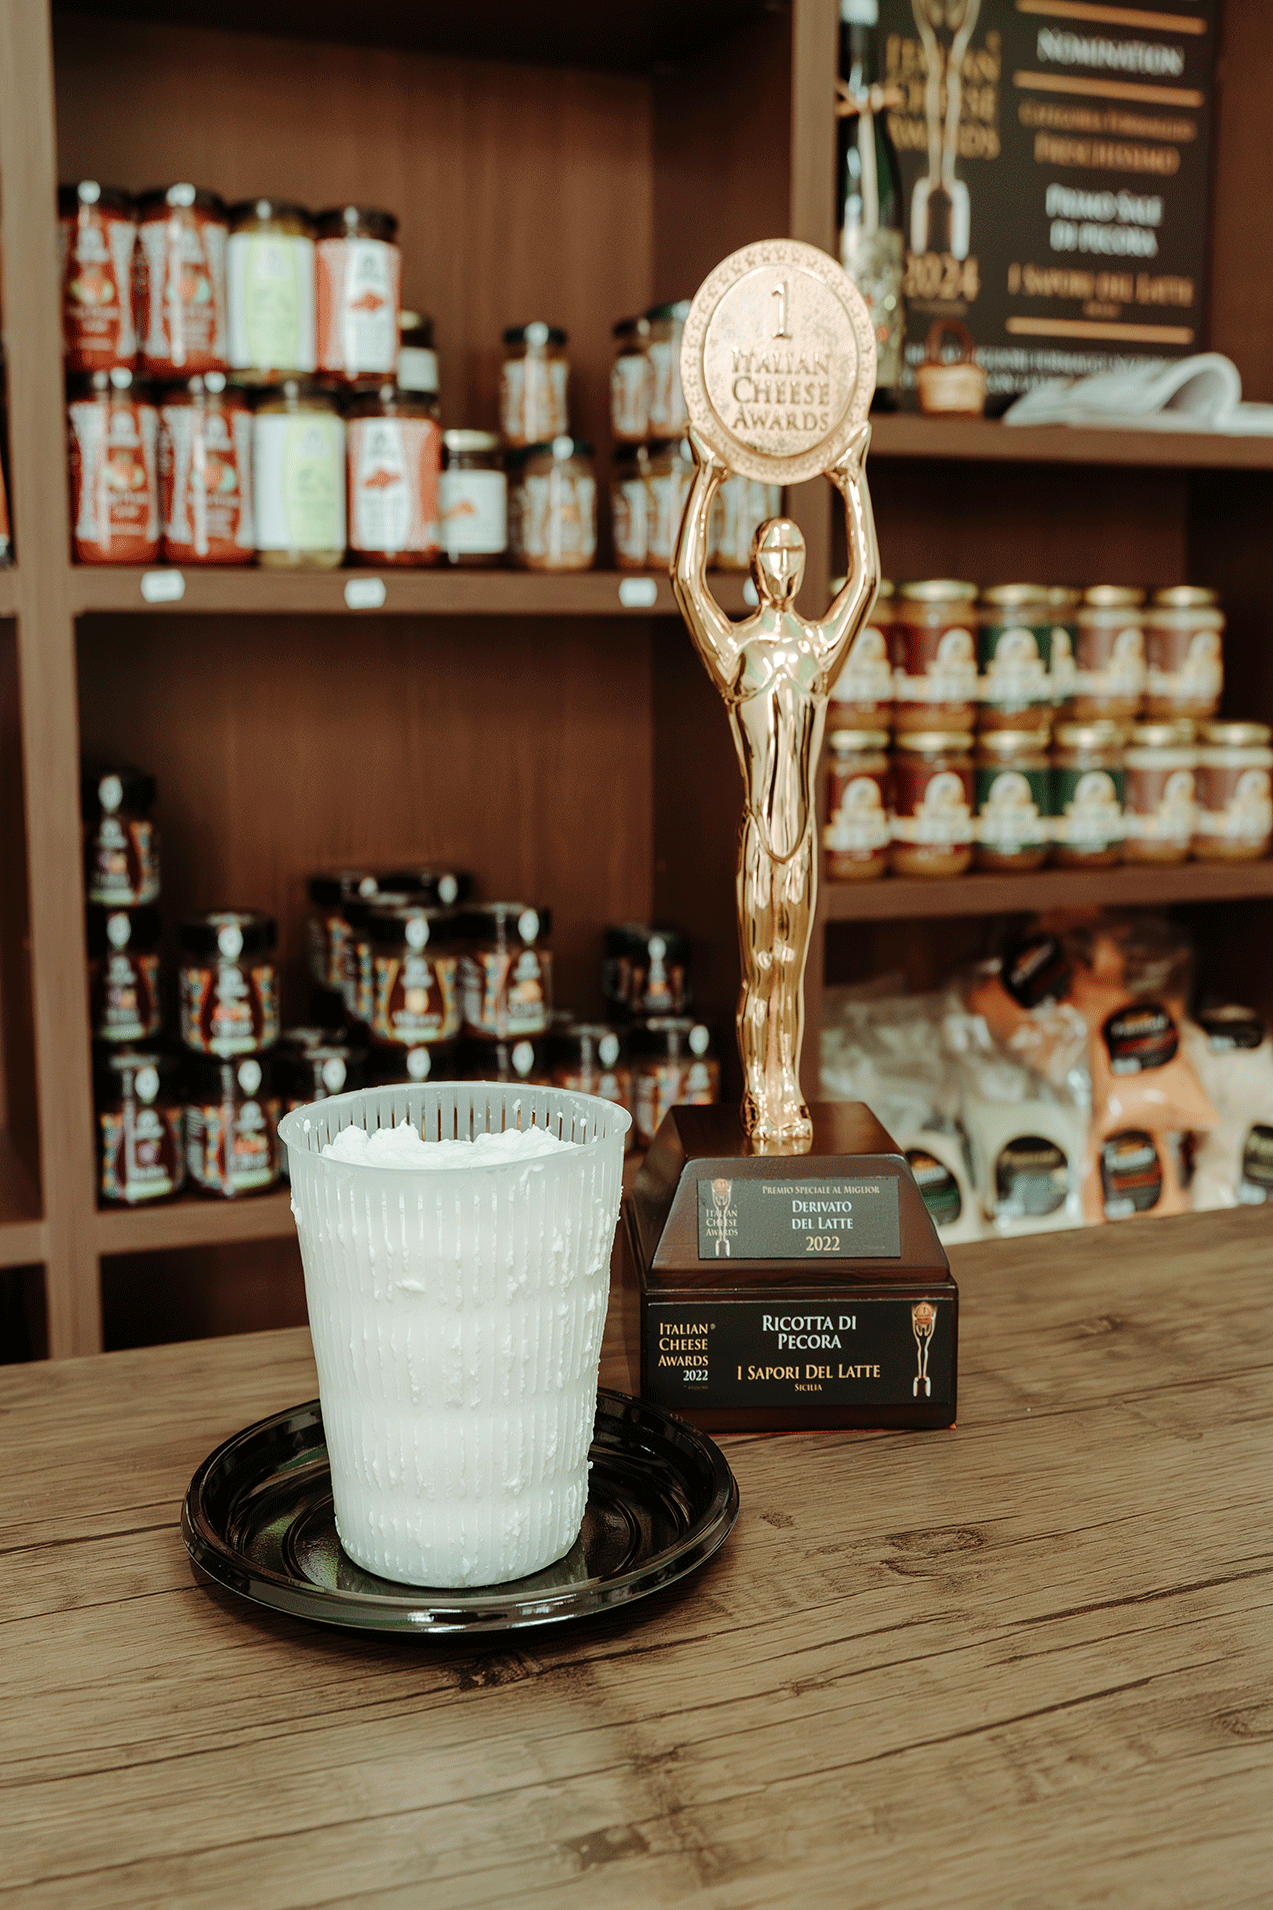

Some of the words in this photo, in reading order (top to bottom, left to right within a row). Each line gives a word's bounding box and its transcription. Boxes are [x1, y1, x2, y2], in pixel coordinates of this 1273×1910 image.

[771, 281, 792, 340] 1
[732, 347, 830, 375] ITALIAN
[732, 376, 829, 405] CHEESE
[732, 405, 829, 431] AWARDS
[762, 1186, 793, 1194] PREMIO
[795, 1185, 830, 1194] SPECIALE
[844, 1185, 880, 1194] MIGLIOR
[706, 1209, 738, 1217] ITALAN
[792, 1200, 852, 1213] DERIVATO
[792, 1218, 814, 1230] DEL
[818, 1217, 853, 1230] LATTE
[805, 1236, 840, 1251] 2022
[762, 1315, 834, 1331] RICOTTA
[839, 1315, 857, 1330] DI
[659, 1338, 708, 1351] CHEESE
[778, 1334, 842, 1349] PECORA
[658, 1354, 709, 1367] AWARDS
[683, 1369, 709, 1381] 2022
[737, 1365, 742, 1380] I
[747, 1365, 800, 1380] SAPORI
[805, 1365, 831, 1379] DEL
[838, 1364, 881, 1378] LATTE
[794, 1383, 823, 1391] SICILIA
